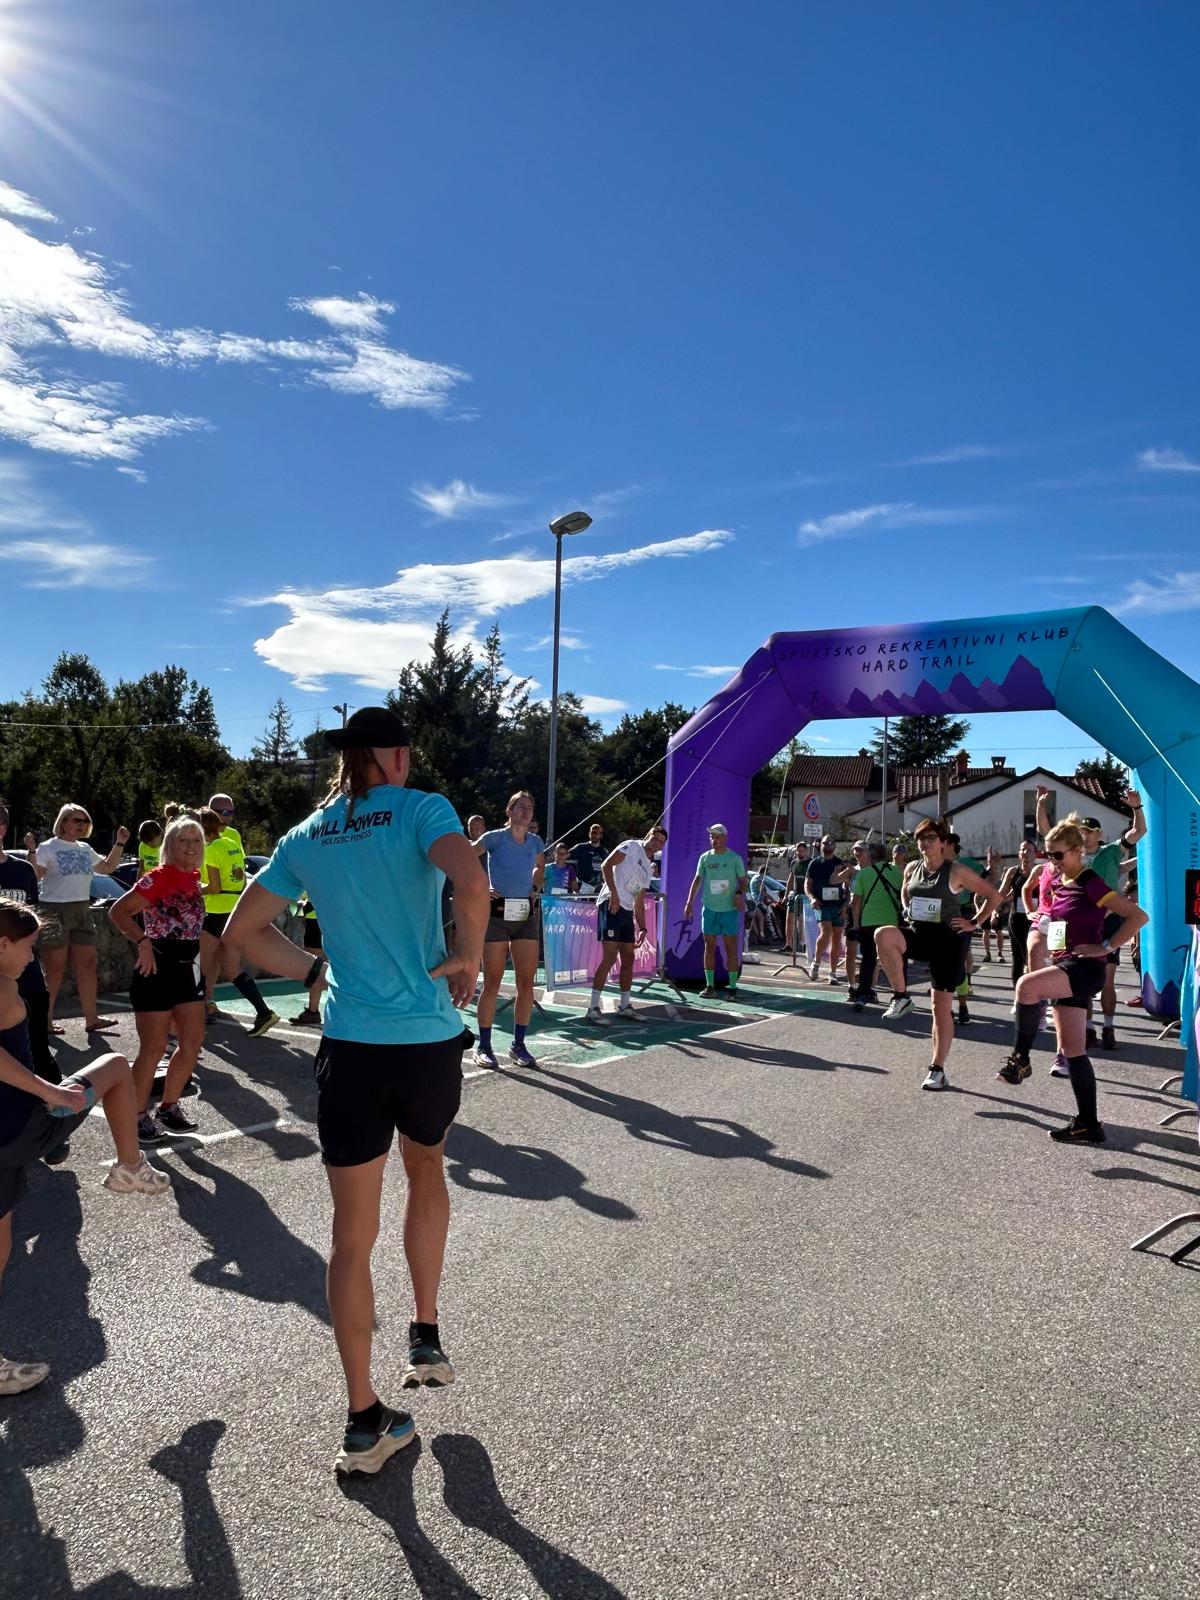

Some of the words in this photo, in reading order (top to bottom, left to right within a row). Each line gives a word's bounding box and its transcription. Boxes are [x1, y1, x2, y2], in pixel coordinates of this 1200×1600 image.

[779, 645, 867, 661] SPORTSKO
[878, 633, 1005, 655] REKREATIVNI
[1017, 627, 1069, 643] KLUB
[862, 659, 909, 673] HARD
[919, 653, 976, 670] TRAIL
[311, 821, 340, 840] WILL
[343, 811, 392, 833] POWER
[1189, 812, 1198, 837] HARD
